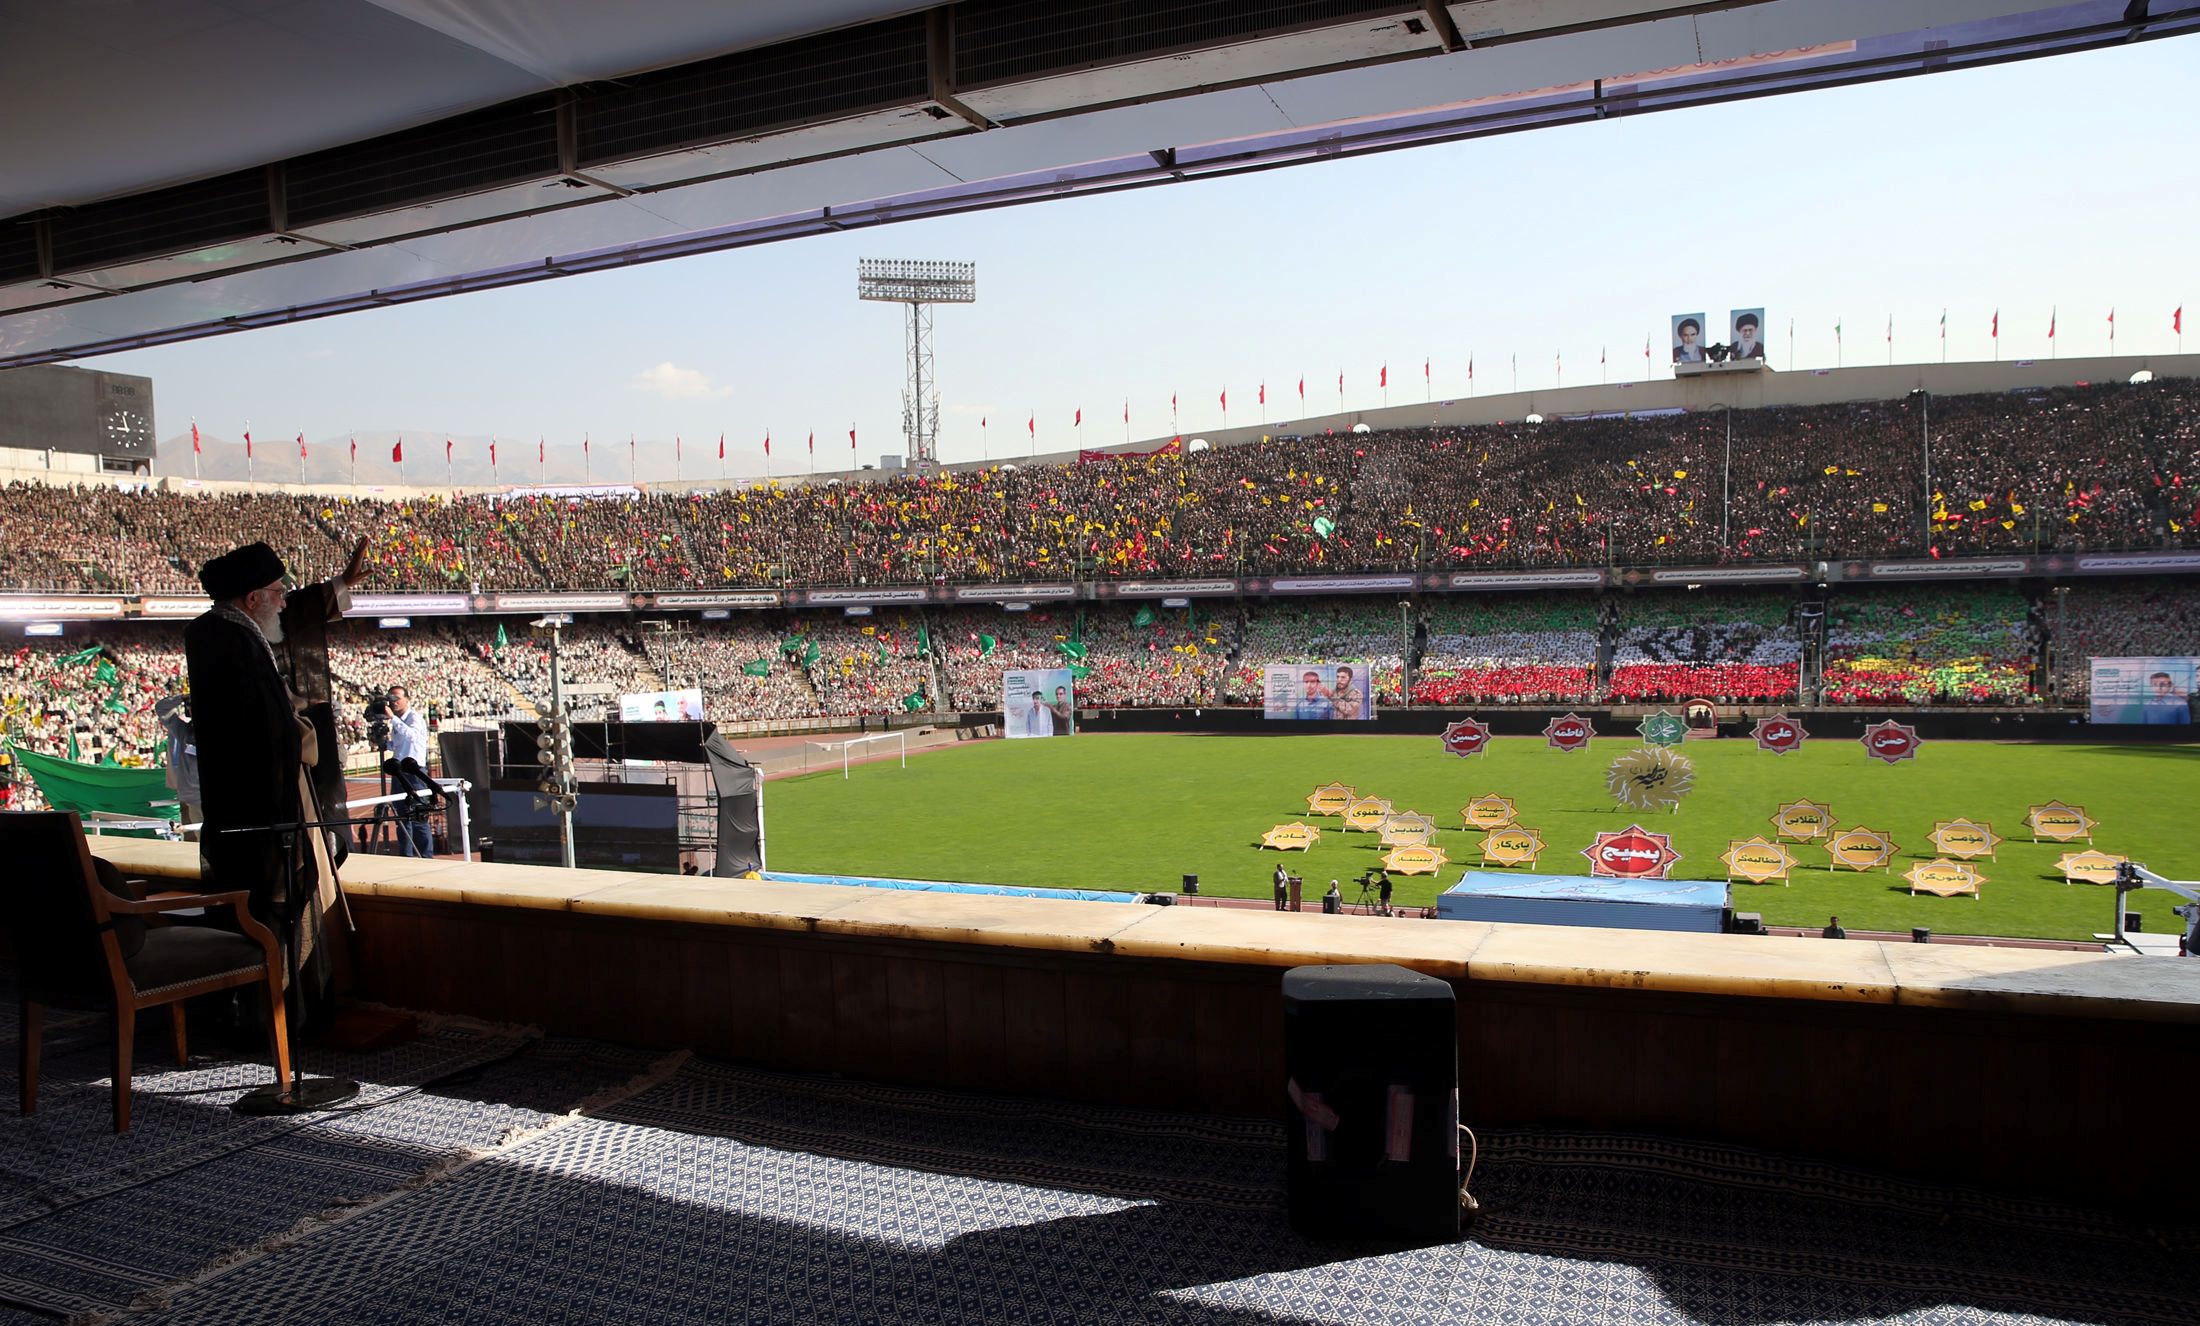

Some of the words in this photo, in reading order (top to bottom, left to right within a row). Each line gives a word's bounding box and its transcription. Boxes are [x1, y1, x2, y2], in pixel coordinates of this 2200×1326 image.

[1554, 727, 1584, 737] فاطمه
[1766, 727, 1793, 741] علی
[1450, 734, 1482, 743] حسین
[1874, 738, 1907, 748] حسن
[1318, 795, 1347, 803] بصیر
[1352, 809, 1385, 818] معنوی
[1785, 815, 1823, 825] انقلابی
[2039, 816, 2081, 825] منتظر
[1274, 832, 1307, 840] خادم
[1840, 843, 1882, 852] مخلص
[1601, 846, 1660, 863] بسیج
